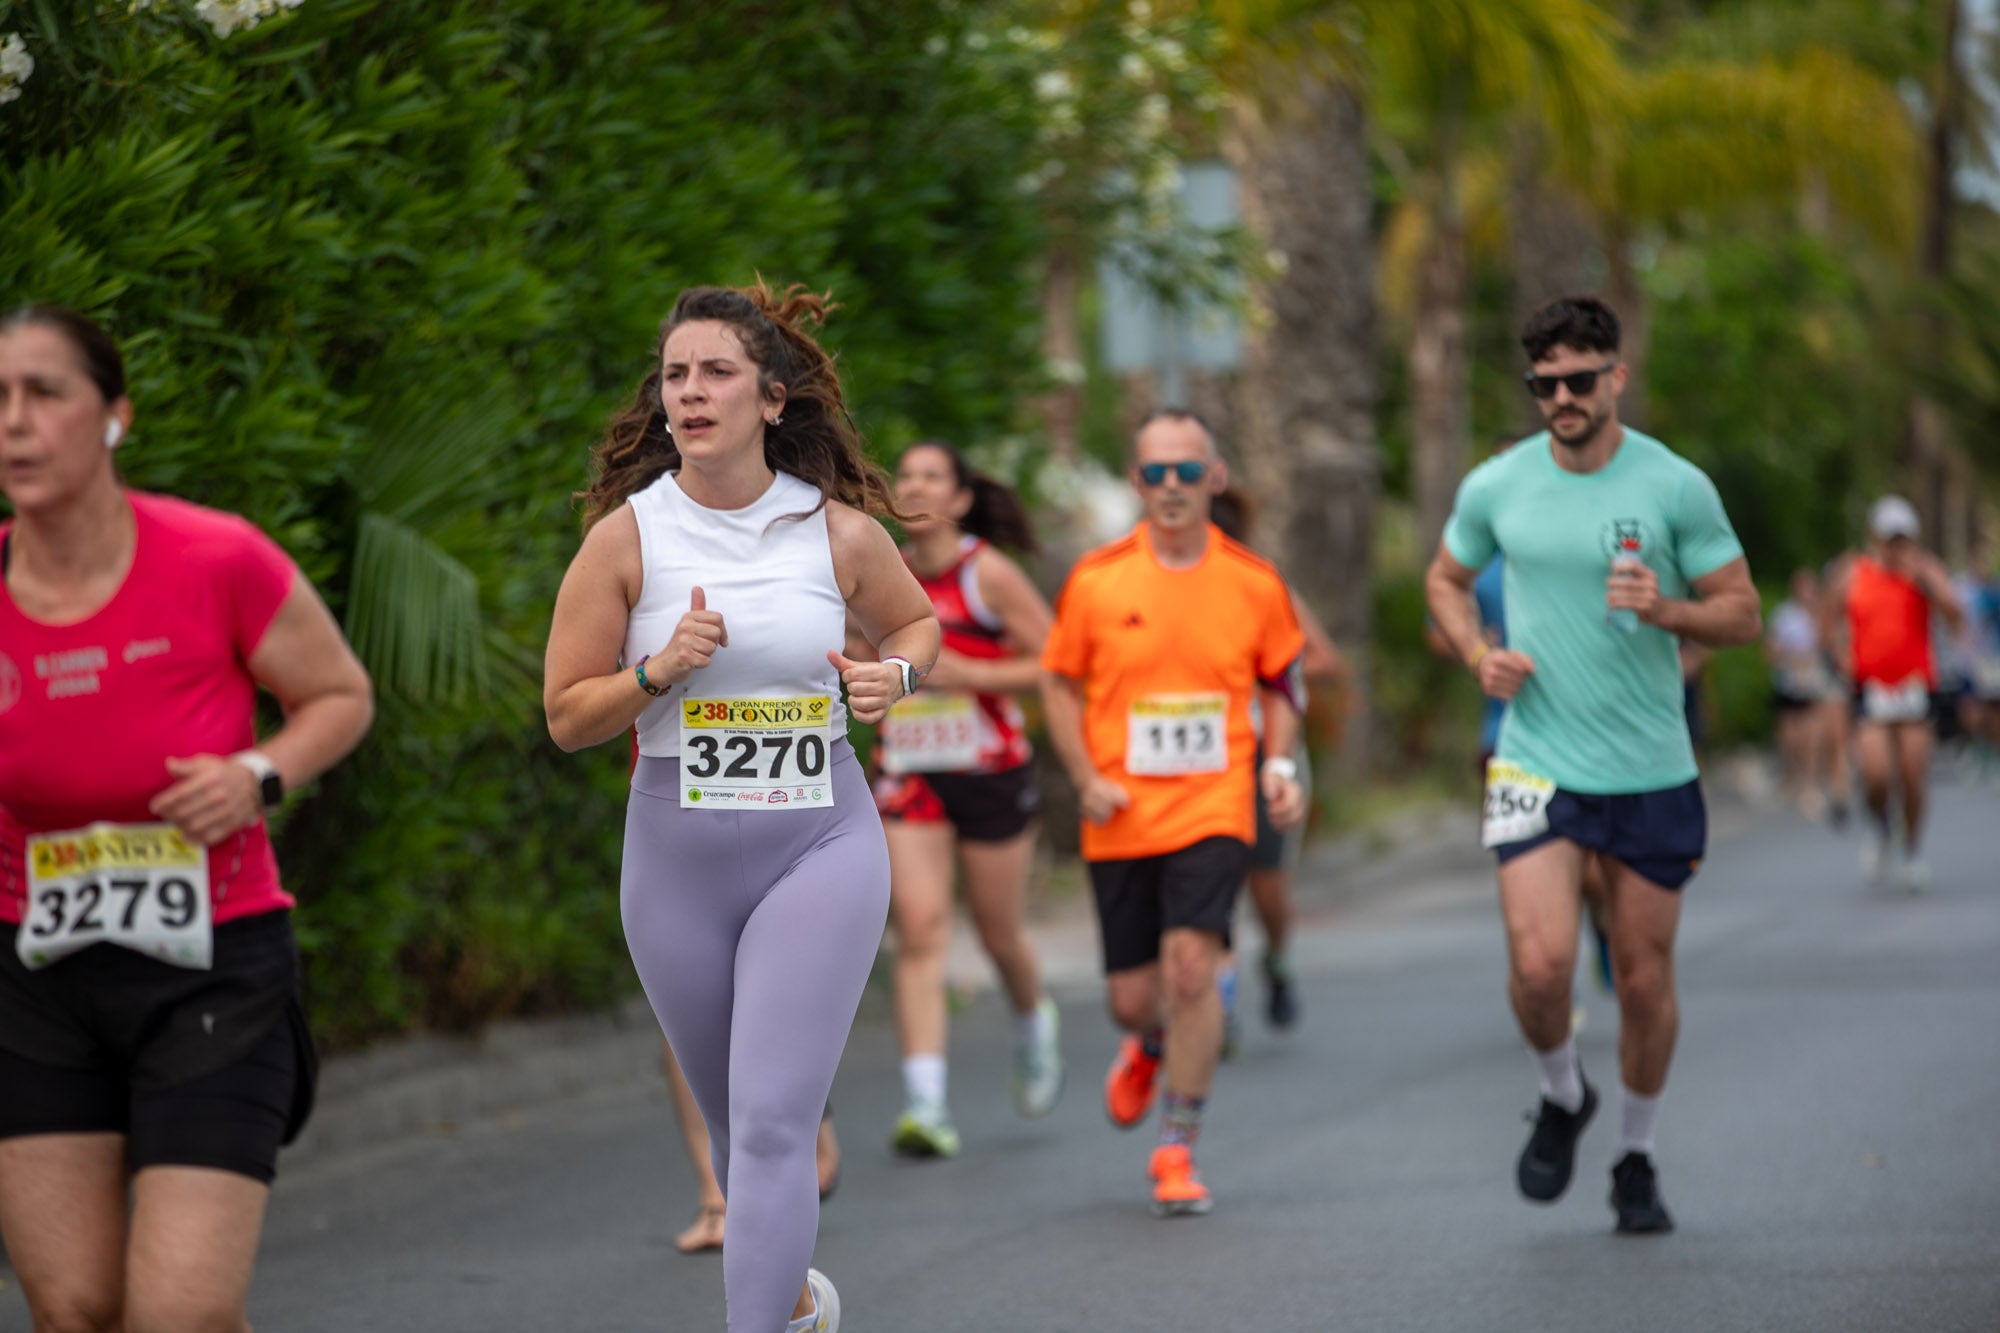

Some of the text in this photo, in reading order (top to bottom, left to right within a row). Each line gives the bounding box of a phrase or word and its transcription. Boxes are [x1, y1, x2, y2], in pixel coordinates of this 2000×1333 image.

[704, 703, 728, 721] 38
[729, 707, 802, 723] FONDO
[687, 734, 825, 779] 3270
[703, 790, 736, 799] Cruzcampo
[31, 877, 198, 938] 3279
